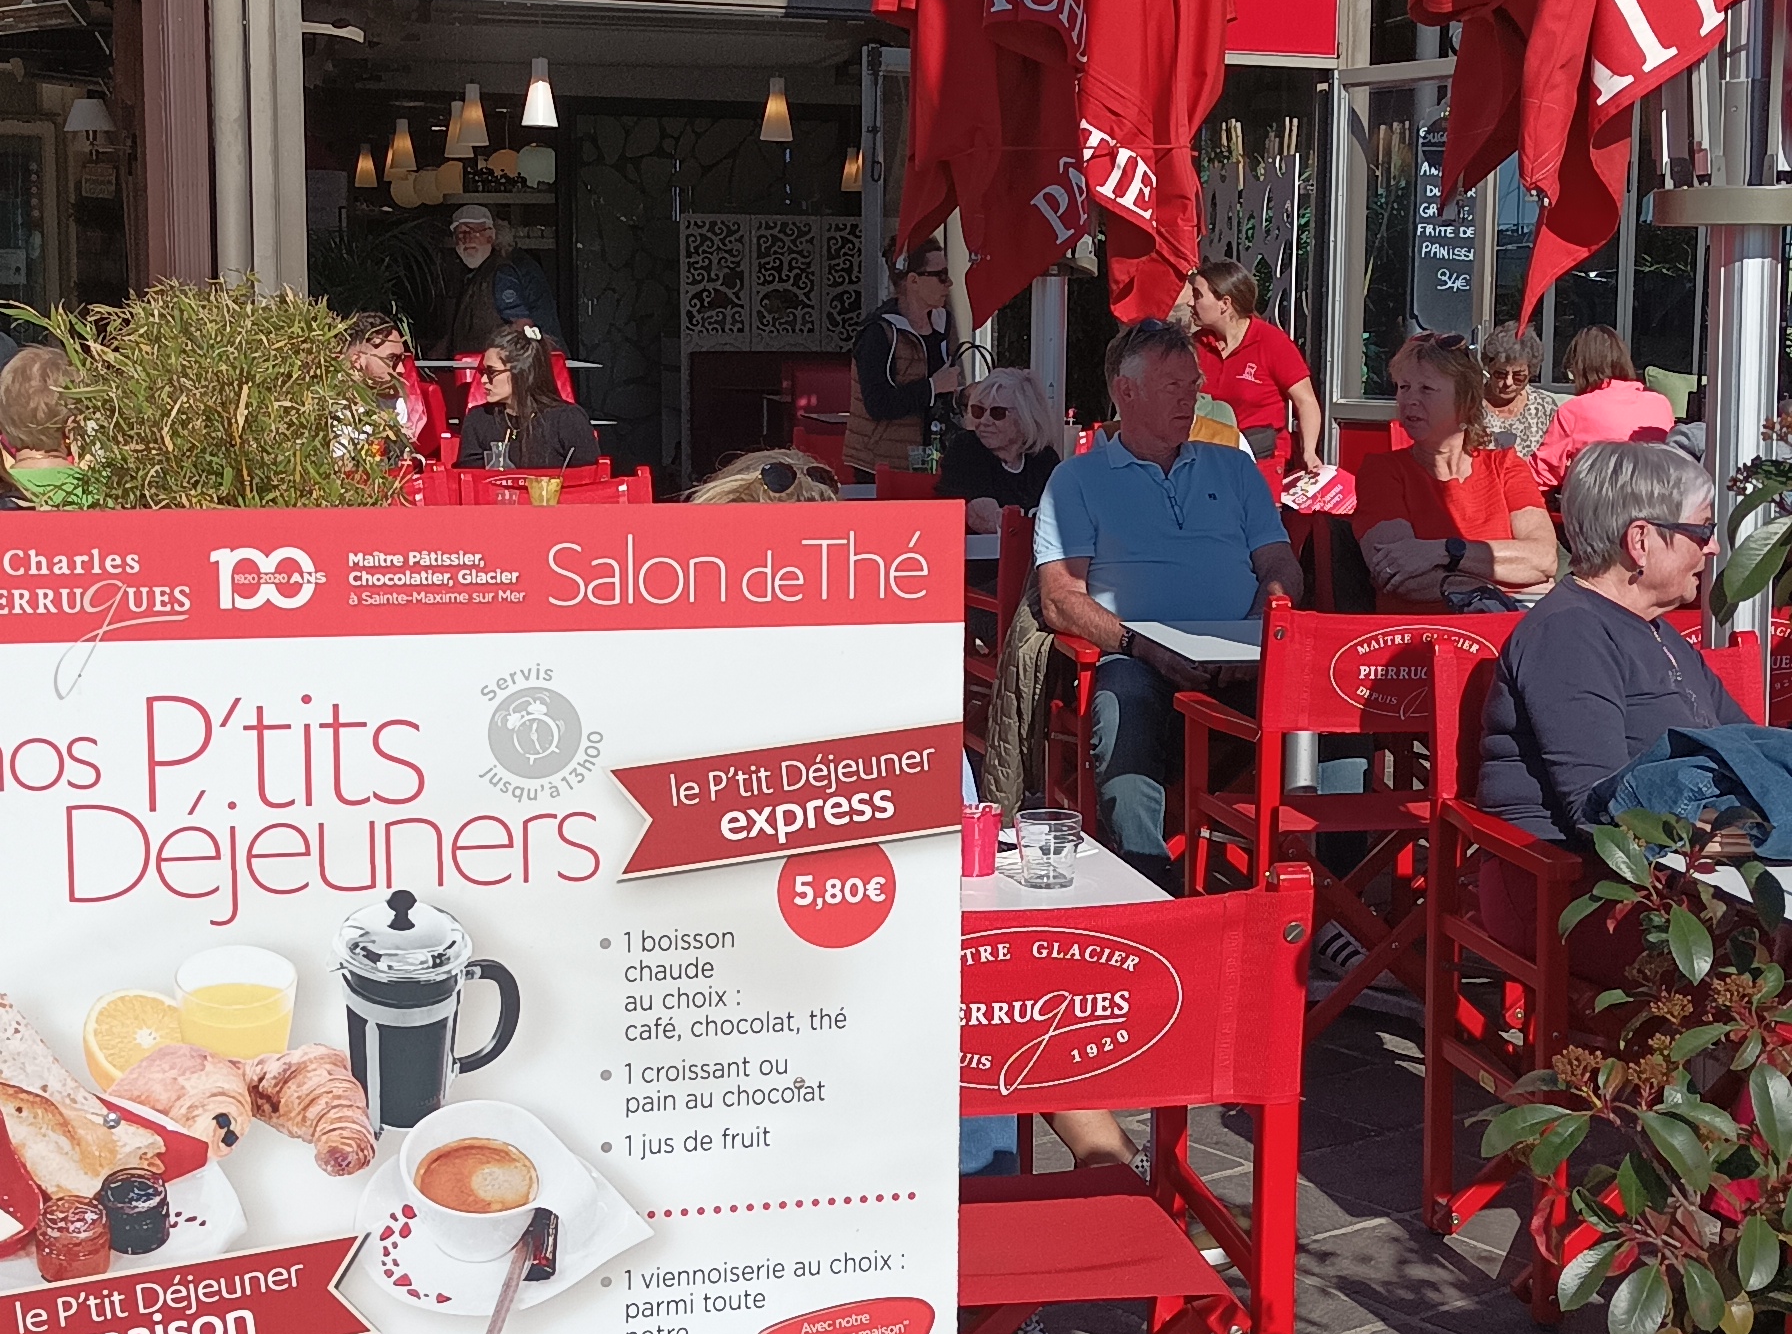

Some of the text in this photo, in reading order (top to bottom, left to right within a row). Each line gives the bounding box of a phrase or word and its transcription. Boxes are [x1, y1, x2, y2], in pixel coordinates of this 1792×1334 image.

[1417, 224, 1475, 238] FRITE DE
[3, 548, 140, 576] Charles
[349, 550, 485, 567] Maître Pâtissier,
[547, 530, 929, 607] Salon de Thé
[209, 546, 316, 609] 100
[233, 571, 327, 584] 1920 2020 ANS
[349, 569, 519, 586] Chocolatier, Glacier
[361, 590, 526, 605] Sainte-Maxime sur Mer
[1356, 633, 1412, 655] MAÎTRE
[480, 663, 554, 702] Servis
[145, 693, 425, 812] P'tits
[479, 731, 604, 803] jusqu'à 13h00
[669, 747, 936, 806] le P'tit Déjeuner
[719, 789, 895, 844] express
[66, 789, 602, 926] Déjeuners
[793, 874, 886, 911] 5,80€
[641, 929, 735, 953] boisson
[1032, 941, 1140, 972] GLACIER
[624, 957, 715, 983] chaude
[662, 986, 728, 1010] choix
[624, 1007, 848, 1042] café, chocolat, thé
[1071, 1029, 1129, 1063] 1920
[641, 1058, 750, 1083] croissant
[625, 1081, 825, 1118] pain chocolat
[640, 1126, 771, 1161] jus de fruit
[640, 1250, 893, 1290] viennoiserie choix
[14, 1263, 303, 1334] le P'tit Déjeuner
[624, 1289, 766, 1323] parmi toute
[801, 1313, 870, 1334] Avec notre
